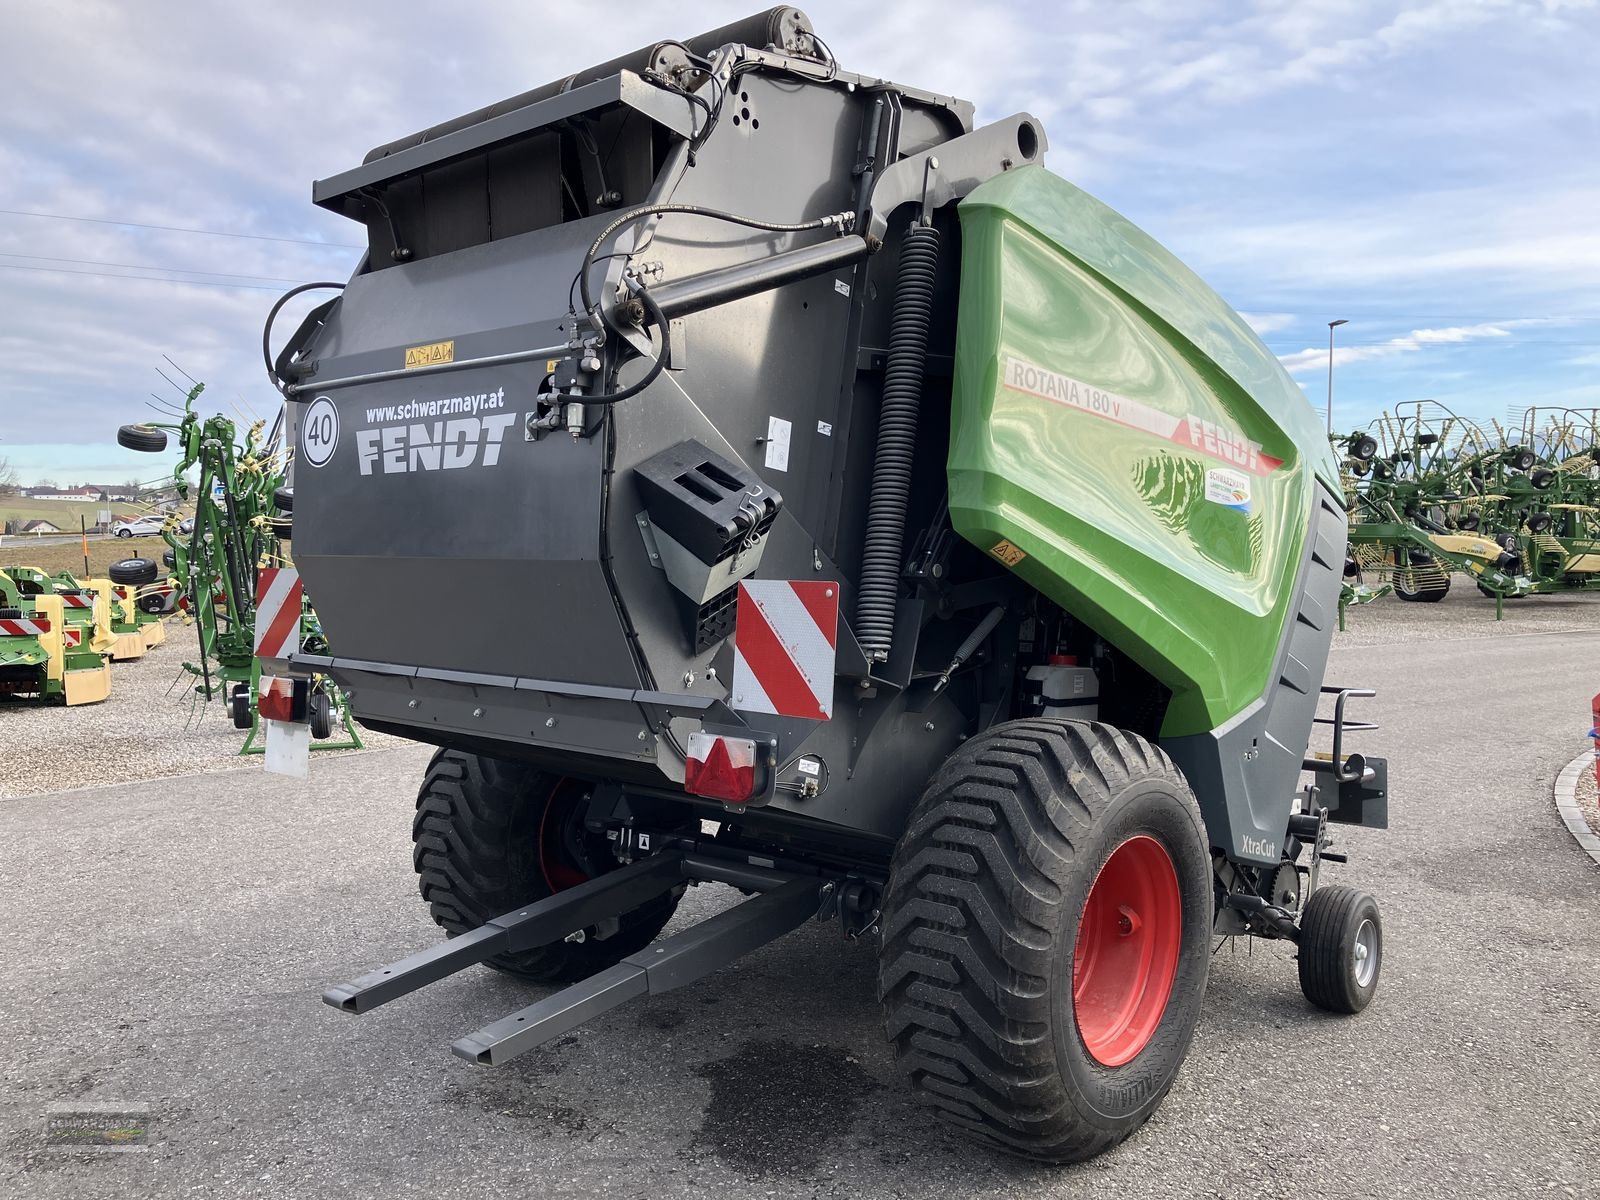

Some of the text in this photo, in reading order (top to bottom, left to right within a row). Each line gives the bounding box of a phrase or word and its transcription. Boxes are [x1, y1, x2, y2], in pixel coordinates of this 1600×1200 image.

[366, 386, 505, 423] www.schwarzmayr.at
[1013, 363, 1120, 417] ROTANA 180 V
[308, 414, 331, 446] 40
[356, 412, 517, 476] FENDT
[1186, 413, 1264, 470] FENDT
[1242, 834, 1276, 858] XtraCut
